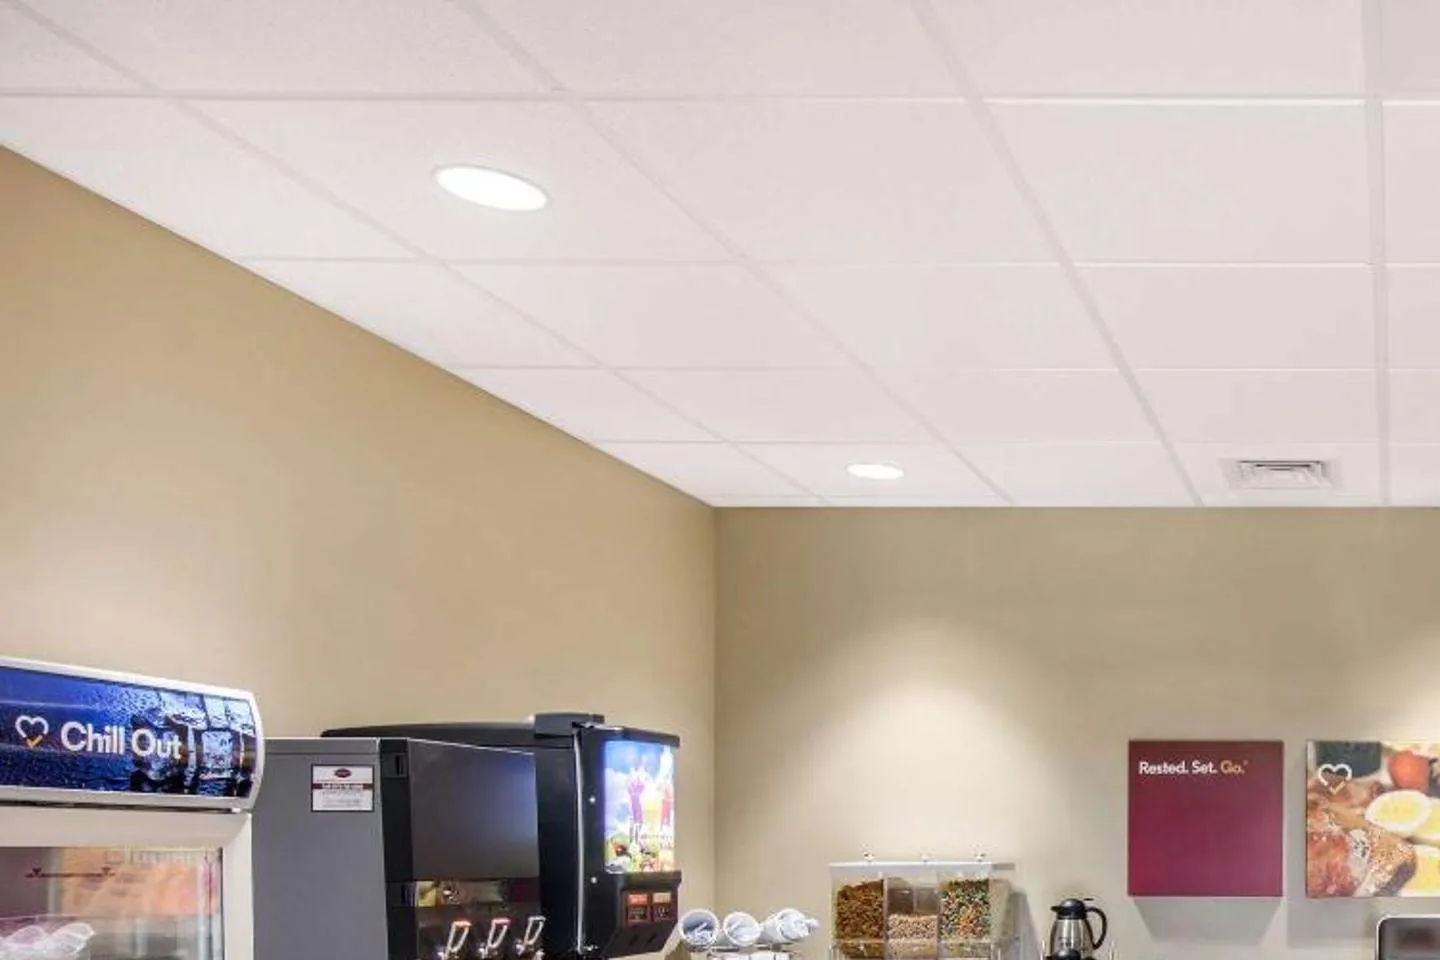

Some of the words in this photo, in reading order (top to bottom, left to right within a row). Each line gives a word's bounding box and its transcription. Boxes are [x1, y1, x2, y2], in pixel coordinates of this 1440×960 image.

[60, 720, 126, 755] Chill
[131, 728, 182, 760] Out
[1138, 760, 1189, 774] Rested.
[1191, 760, 1218, 774] Set.
